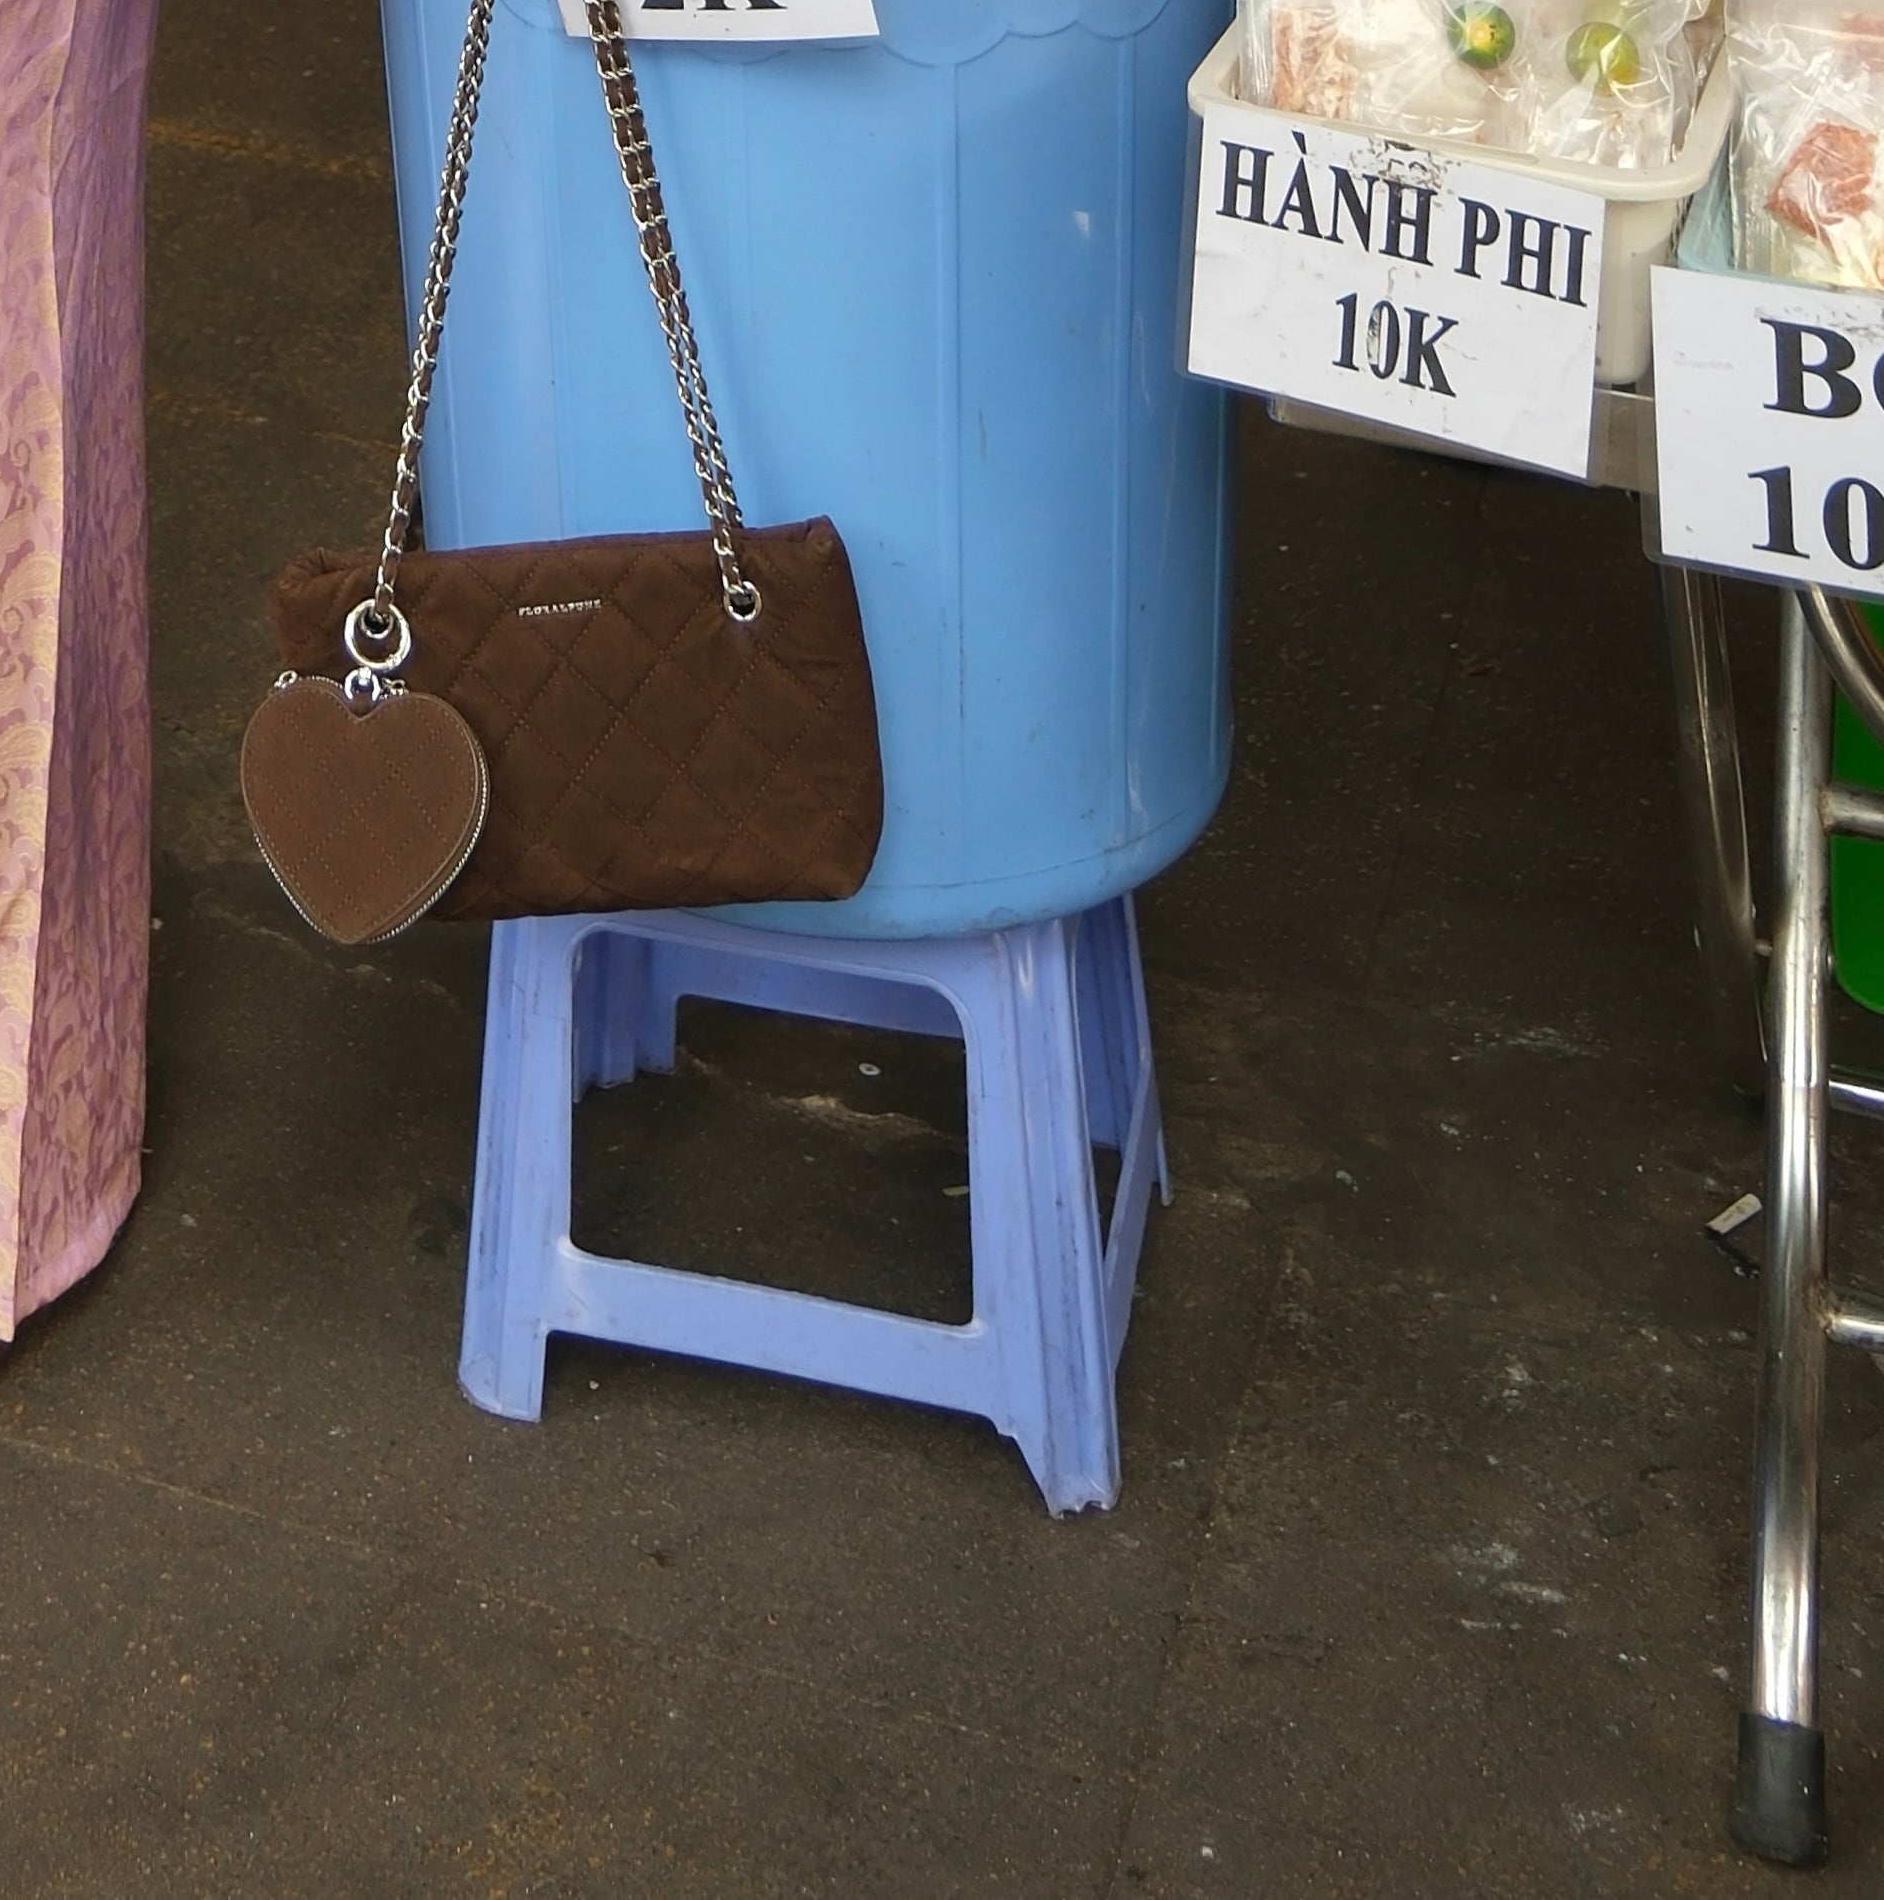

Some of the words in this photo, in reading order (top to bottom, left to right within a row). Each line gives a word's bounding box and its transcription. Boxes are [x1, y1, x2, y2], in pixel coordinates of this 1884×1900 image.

[1216, 131, 1440, 267] HÀNH
[1453, 195, 1593, 309] PHI
[1331, 291, 1460, 399] 10K
[1759, 317, 1884, 421] B
